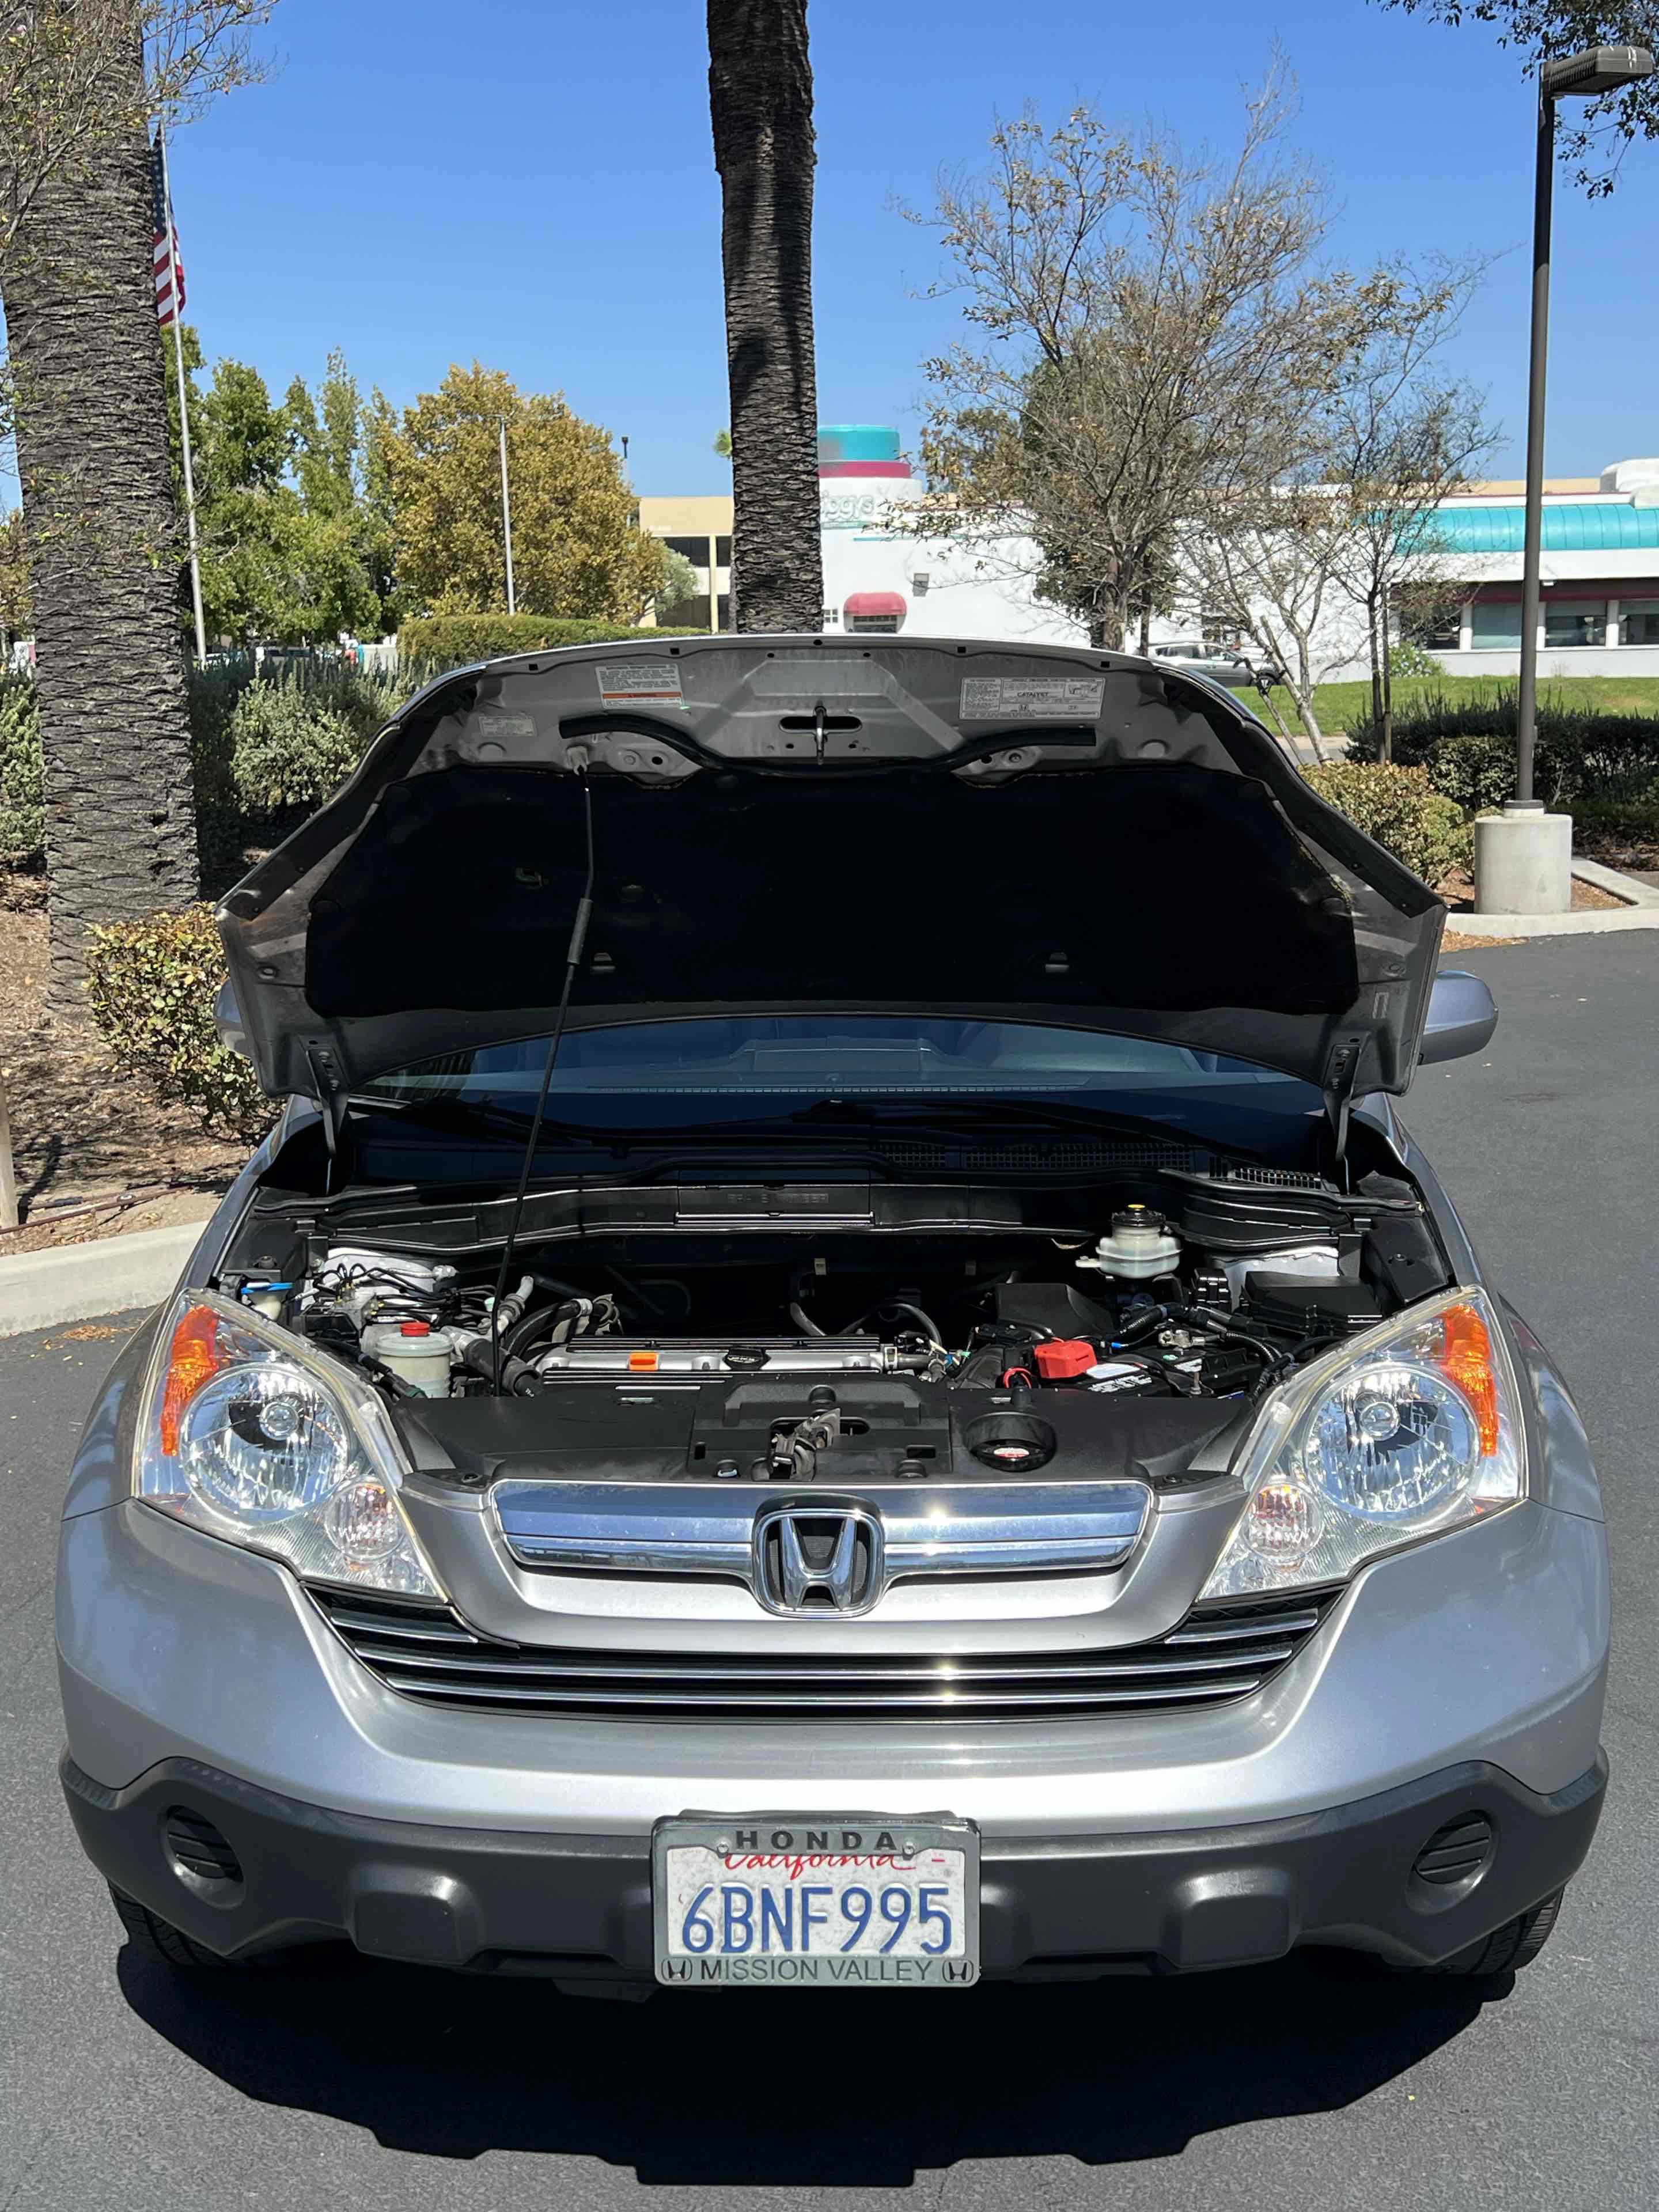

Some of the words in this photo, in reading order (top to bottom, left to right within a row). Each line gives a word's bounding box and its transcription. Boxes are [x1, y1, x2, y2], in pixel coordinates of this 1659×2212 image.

[736, 1830, 897, 1851] HONDA
[682, 1885, 952, 1954] 6BNF995
[700, 1959, 818, 1980] MISSION
[827, 1959, 933, 1981] VALLEY
